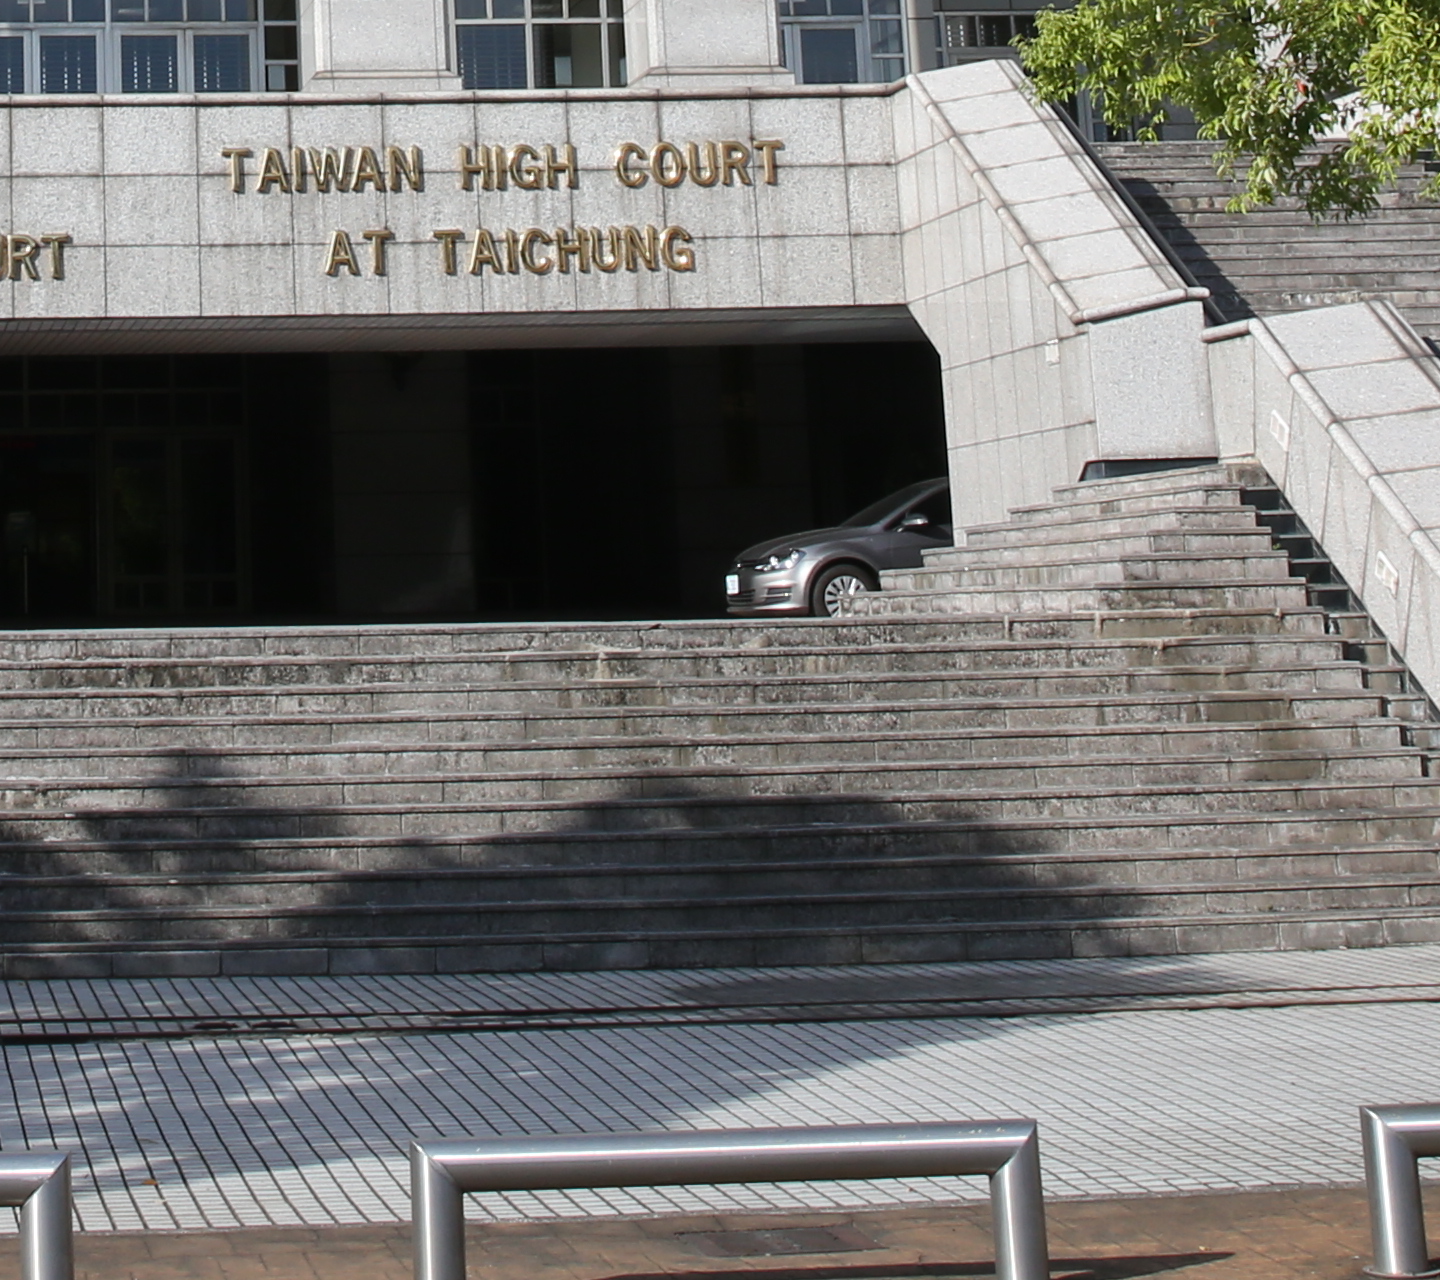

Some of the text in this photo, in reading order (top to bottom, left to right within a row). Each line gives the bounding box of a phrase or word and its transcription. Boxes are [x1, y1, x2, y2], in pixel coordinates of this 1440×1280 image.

[221, 138, 785, 193] TAIWAN HIGH COURT
[324, 224, 696, 277] AT TAICHUNG
